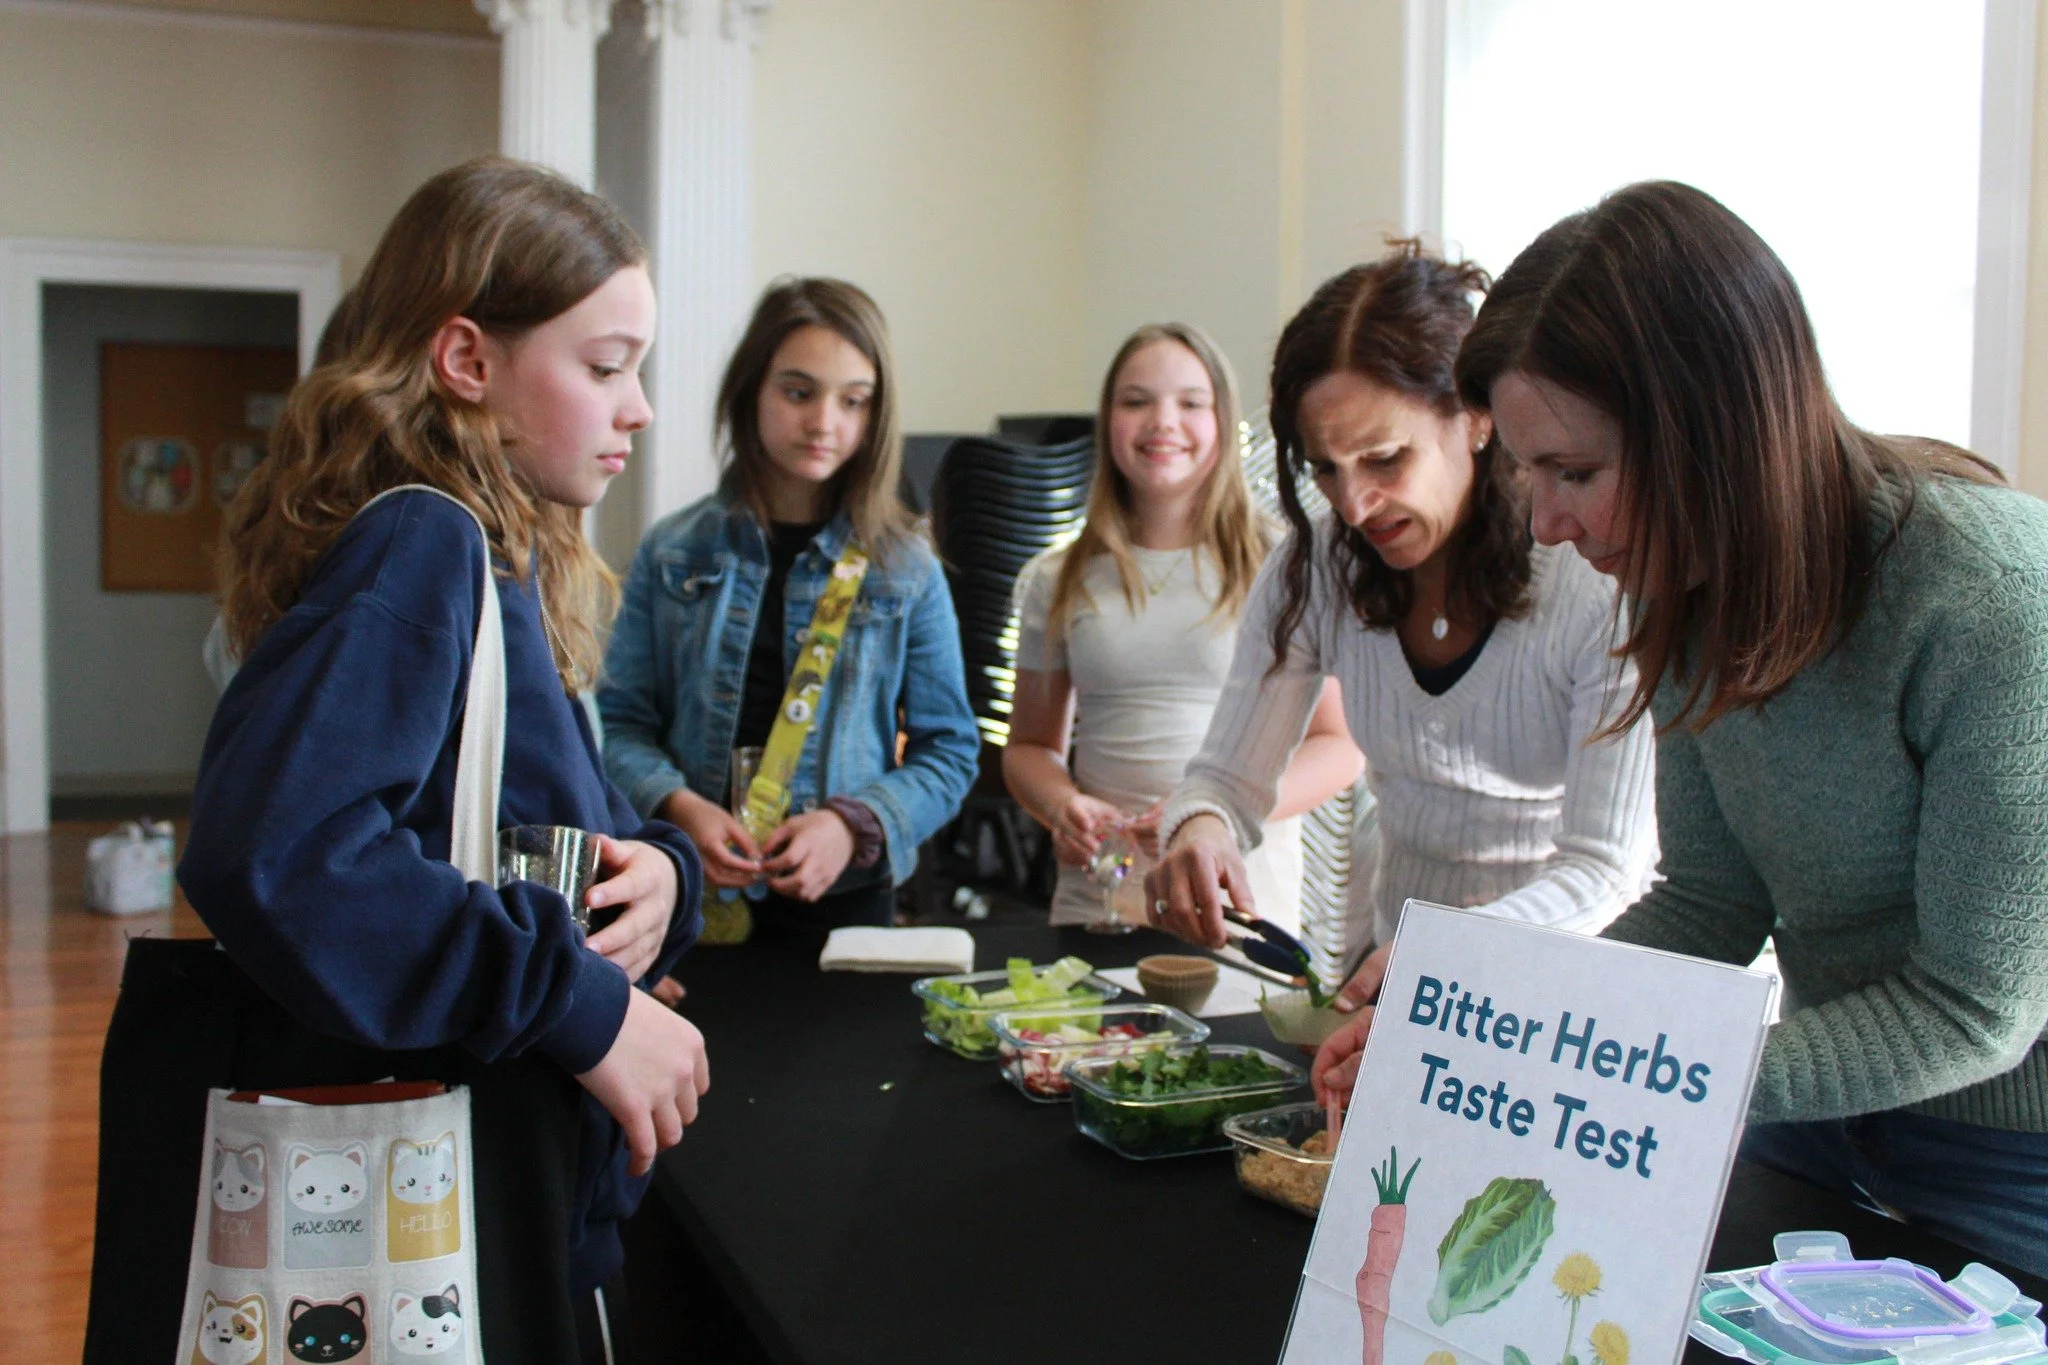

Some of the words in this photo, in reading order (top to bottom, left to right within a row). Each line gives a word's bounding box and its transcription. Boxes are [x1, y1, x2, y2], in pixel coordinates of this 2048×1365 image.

[1408, 974, 1544, 1055] Bitter
[1550, 1011, 1712, 1103] Herbs
[1419, 1052, 1536, 1137] Taste
[1552, 1092, 1659, 1179] Test
[400, 1211, 452, 1234] HELLO
